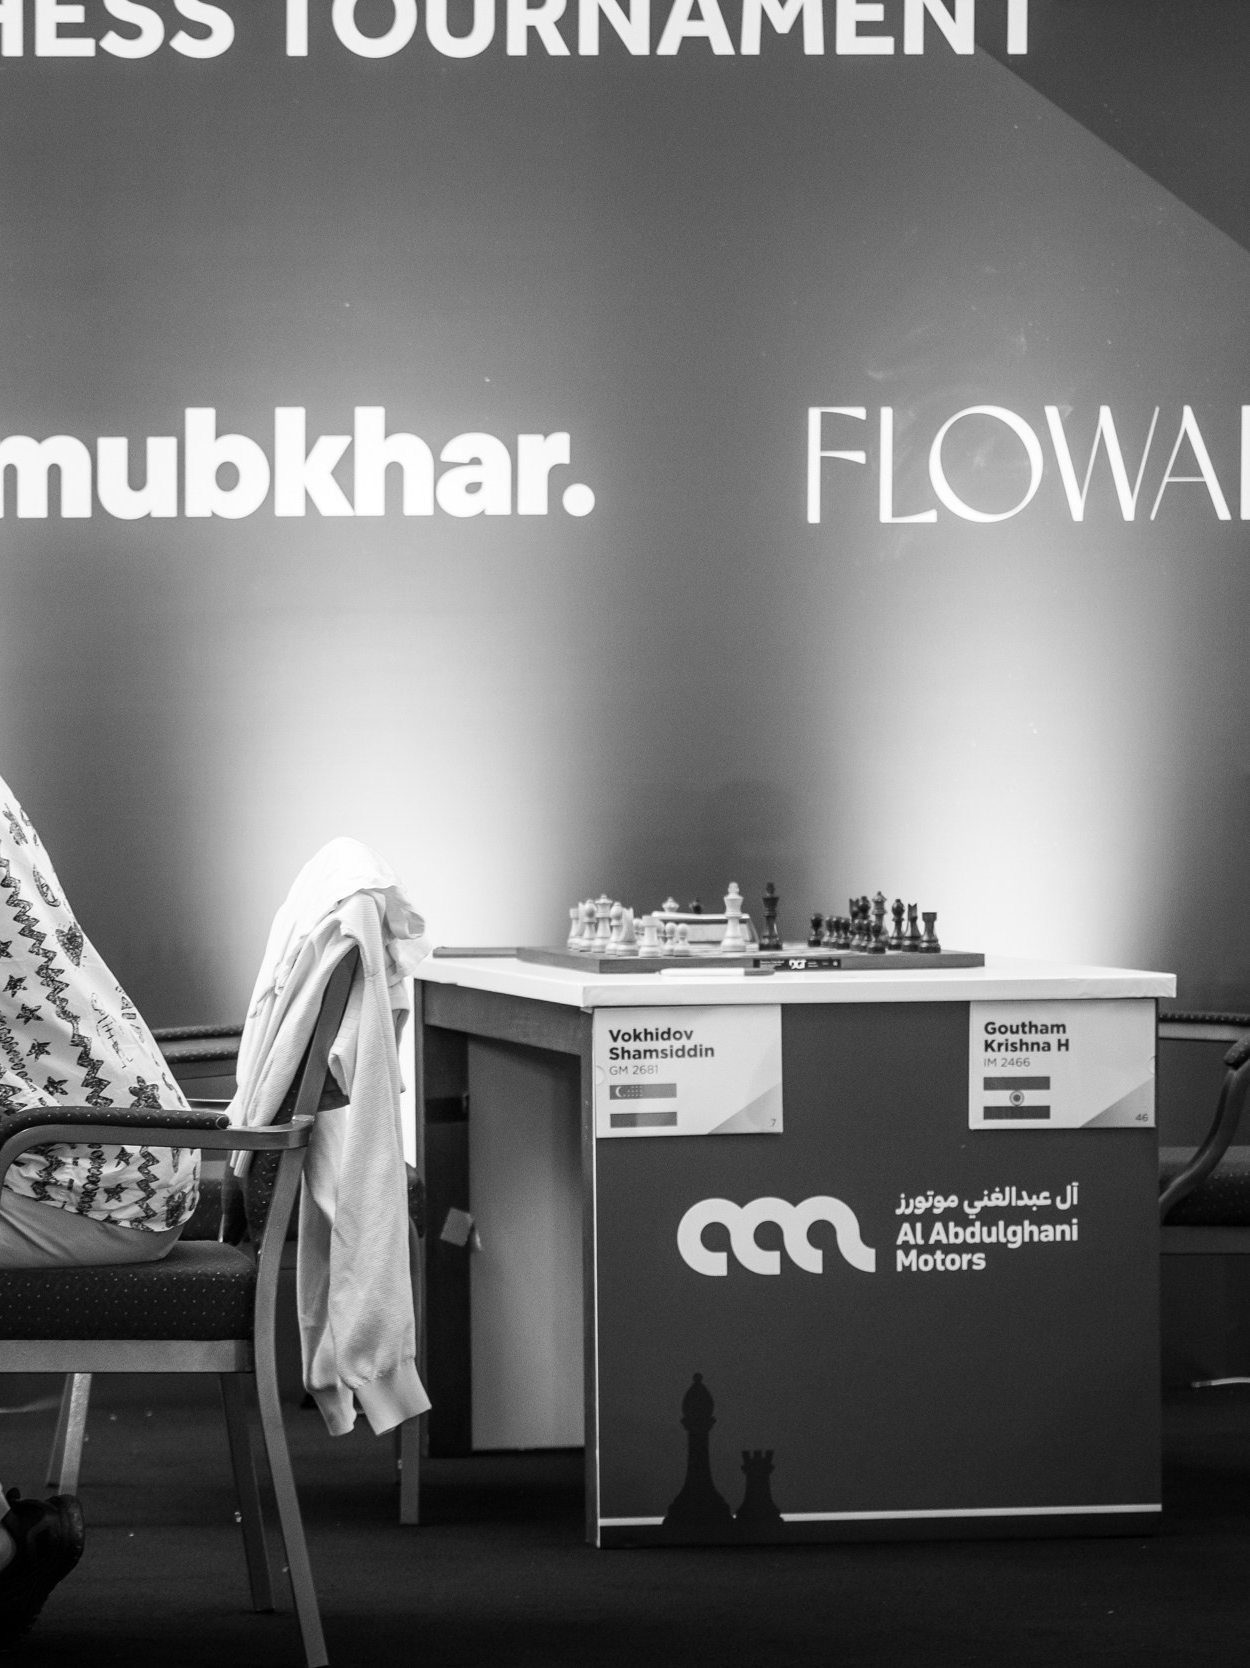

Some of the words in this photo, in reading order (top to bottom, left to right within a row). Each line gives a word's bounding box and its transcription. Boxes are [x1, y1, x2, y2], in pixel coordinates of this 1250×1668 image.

[807, 404, 1250, 524] FLOWA
[608, 1027, 694, 1043] Vokhidov
[984, 1020, 1067, 1036] Goutham
[608, 1044, 715, 1061] Shamsiddin
[984, 1038, 1052, 1053] Krishna
[1057, 1038, 1070, 1052] H
[609, 1066, 629, 1076] GM
[632, 1064, 659, 1075] 2681
[982, 1058, 998, 1068] IM
[1000, 1057, 1031, 1068] 2466
[1134, 1113, 1149, 1123] 46
[895, 1190, 959, 1216] موتورز
[963, 1185, 1052, 1219] عبدالغني
[1055, 1181, 1079, 1211] آل
[896, 1222, 925, 1246] Al
[928, 1216, 1079, 1249] Abdulghani
[896, 1248, 987, 1272] Motors
